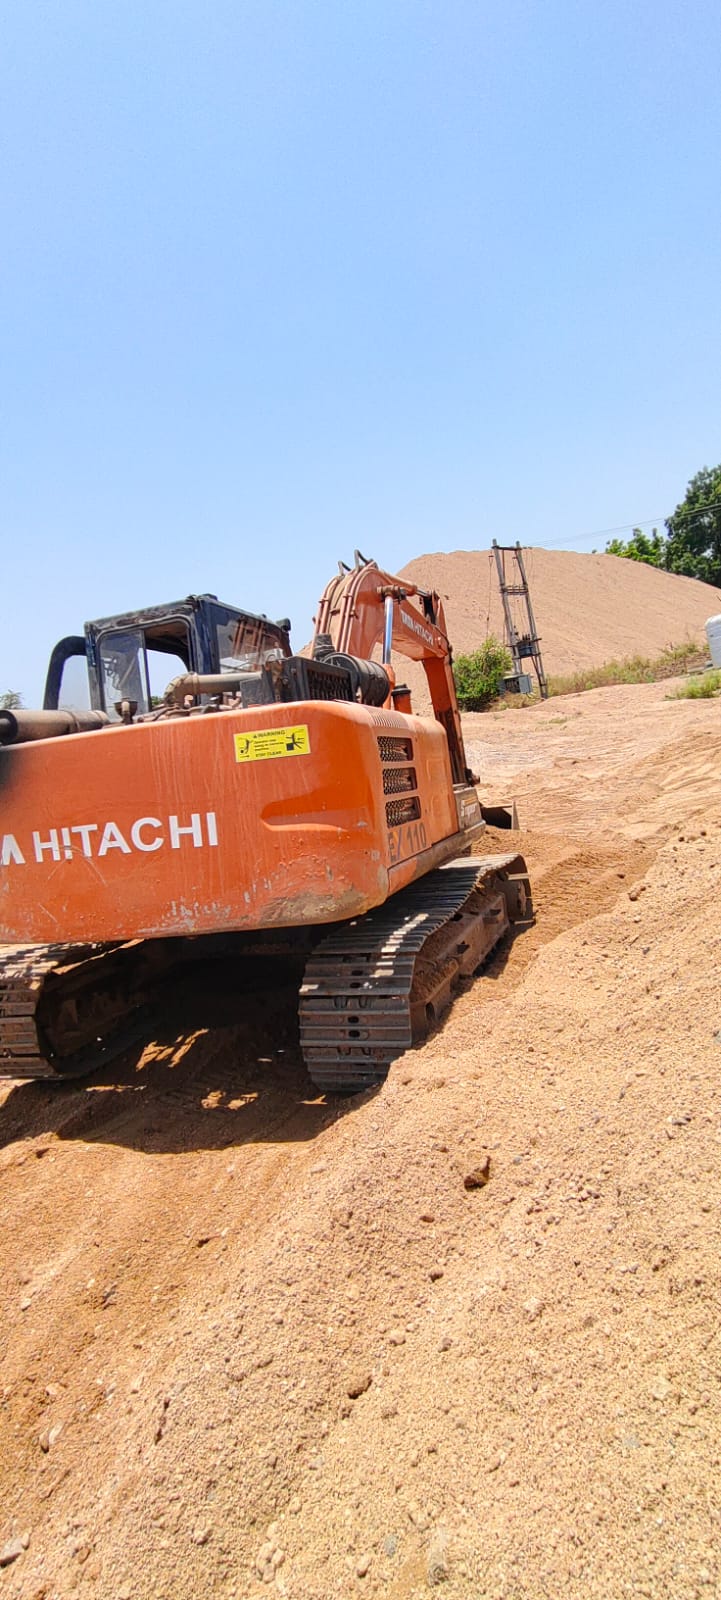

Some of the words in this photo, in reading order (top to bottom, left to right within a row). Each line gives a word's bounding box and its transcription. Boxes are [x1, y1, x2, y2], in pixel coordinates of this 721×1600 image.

[413, 620, 434, 647] HITACHI
[257, 730, 286, 738] WARNING
[32, 812, 219, 863] HITACHI
[388, 827, 402, 863] EX
[406, 821, 427, 854] 110
